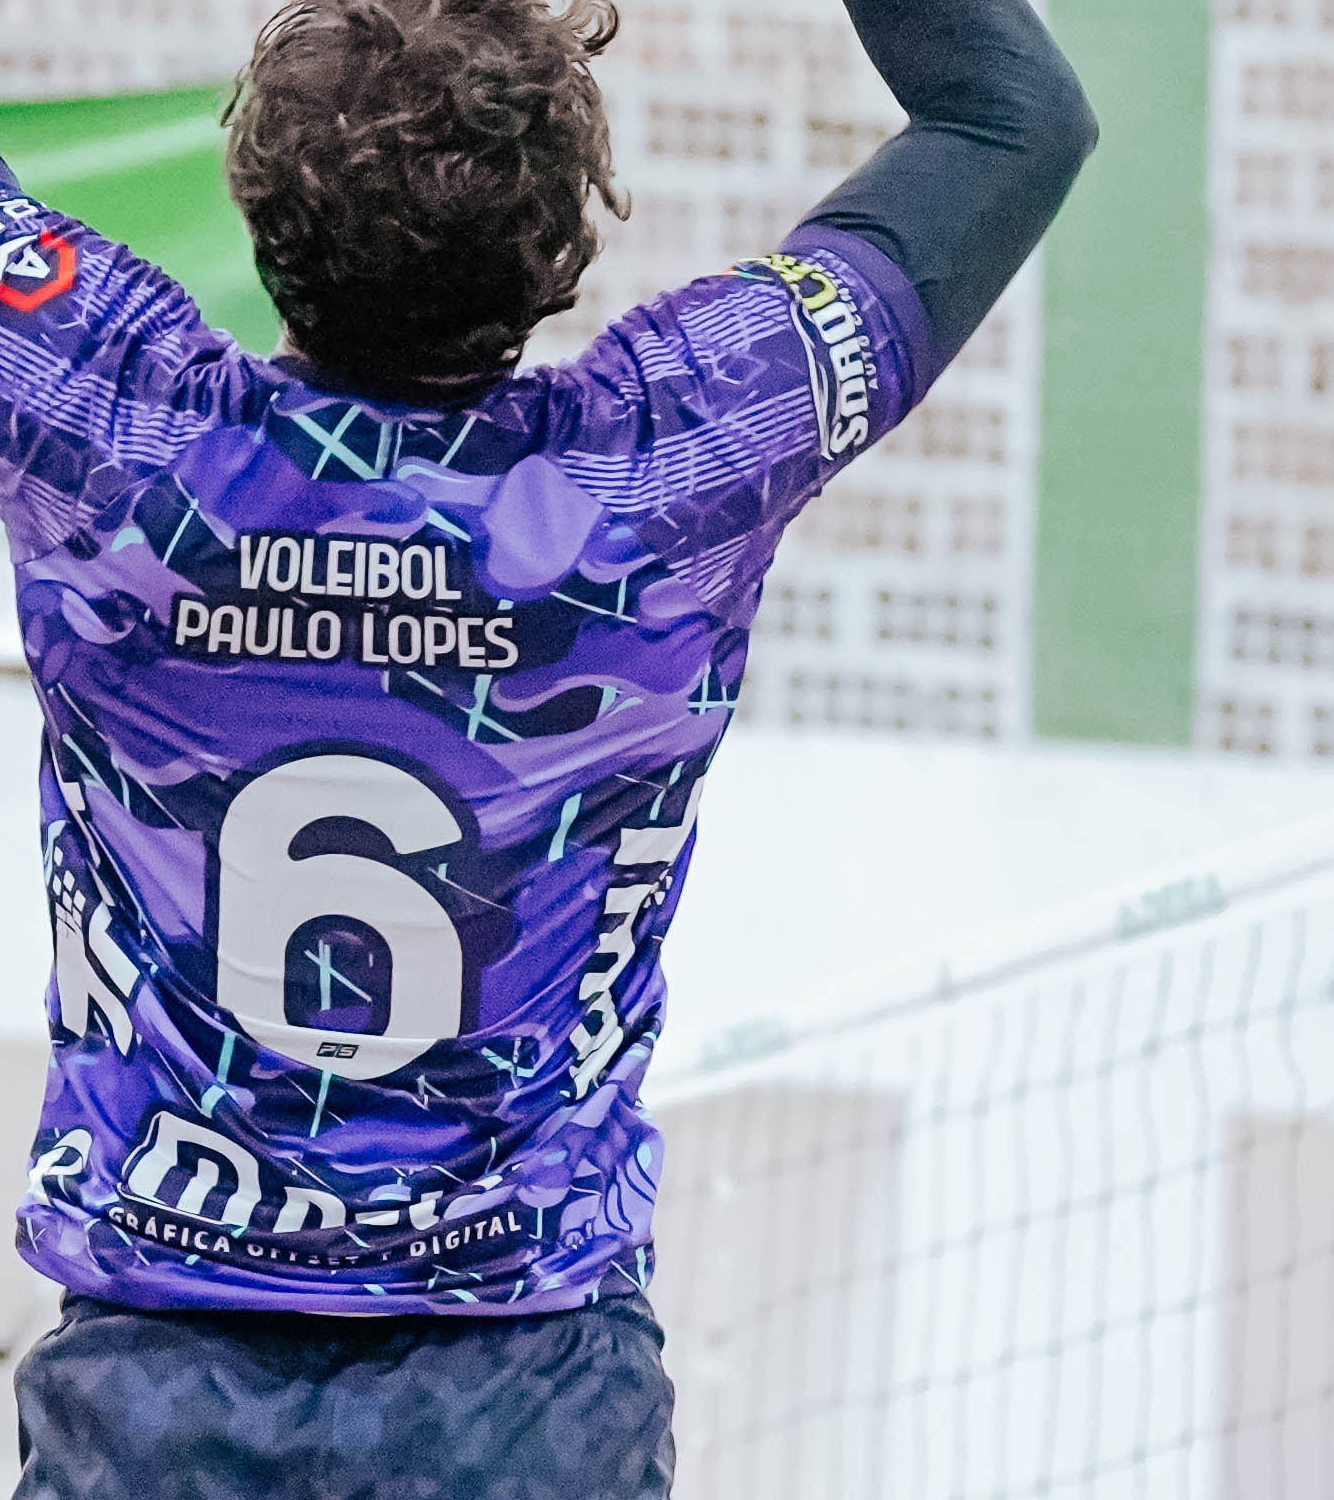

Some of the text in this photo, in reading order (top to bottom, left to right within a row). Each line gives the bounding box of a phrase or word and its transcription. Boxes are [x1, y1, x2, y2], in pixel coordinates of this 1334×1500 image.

[240, 535, 463, 601] VOLEIBOL
[175, 599, 520, 669] PAULO LOPES
[218, 755, 463, 1081] 6
[108, 1206, 231, 1254] GRÁFICA
[409, 1211, 523, 1258] DIGITAL
